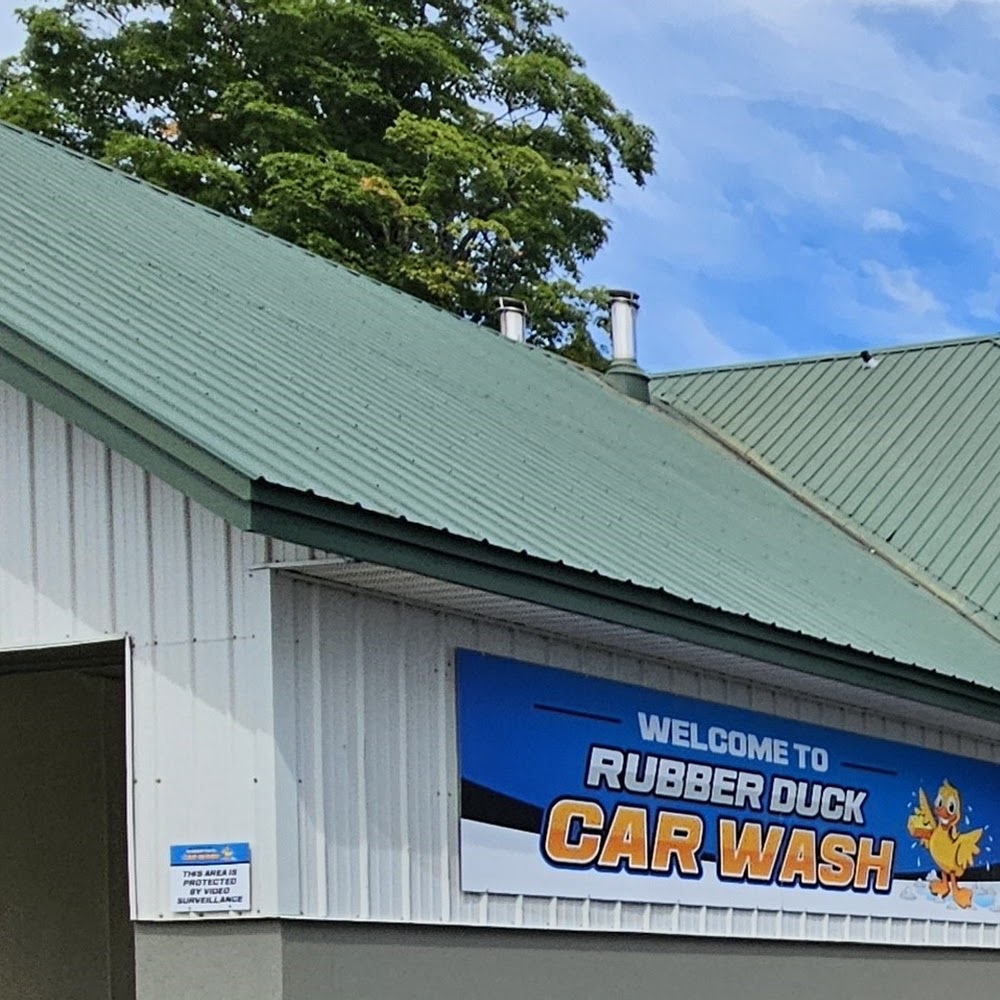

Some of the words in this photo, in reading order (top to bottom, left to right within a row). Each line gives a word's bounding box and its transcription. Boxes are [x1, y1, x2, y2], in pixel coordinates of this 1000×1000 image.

[637, 711, 789, 766] WELCOME
[793, 742, 829, 773] TO
[586, 746, 764, 810] RUBBER
[769, 777, 867, 824] DUCK
[543, 799, 704, 875] CAR
[718, 819, 896, 892] WASH
[183, 870, 203, 878] THIS
[204, 869, 228, 877] AREA
[183, 878, 237, 887] PROTECTED
[190, 887, 201, 895] BY
[203, 887, 230, 895] VIDEO
[177, 896, 243, 904] SURVEILLANCE
